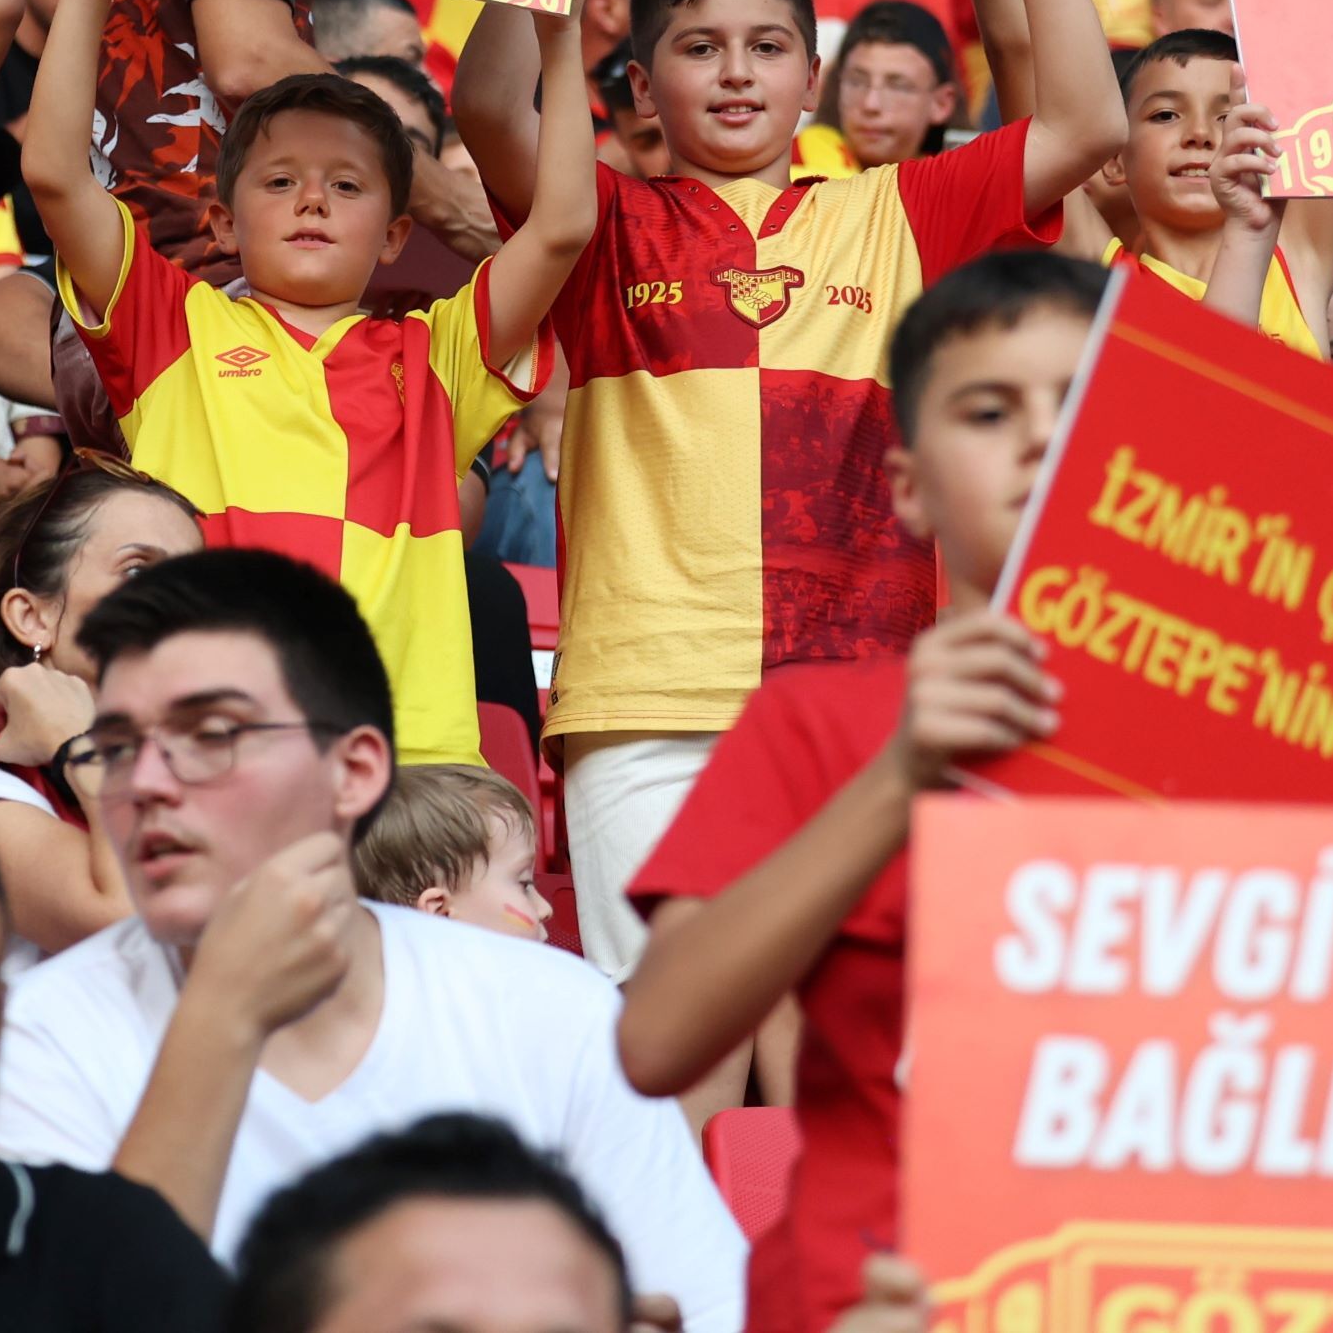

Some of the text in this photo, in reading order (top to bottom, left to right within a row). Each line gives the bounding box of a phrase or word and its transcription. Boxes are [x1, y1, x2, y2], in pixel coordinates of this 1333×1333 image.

[626, 281, 684, 309] 1925
[826, 285, 872, 314] 2025
[218, 367, 262, 378] umbro
